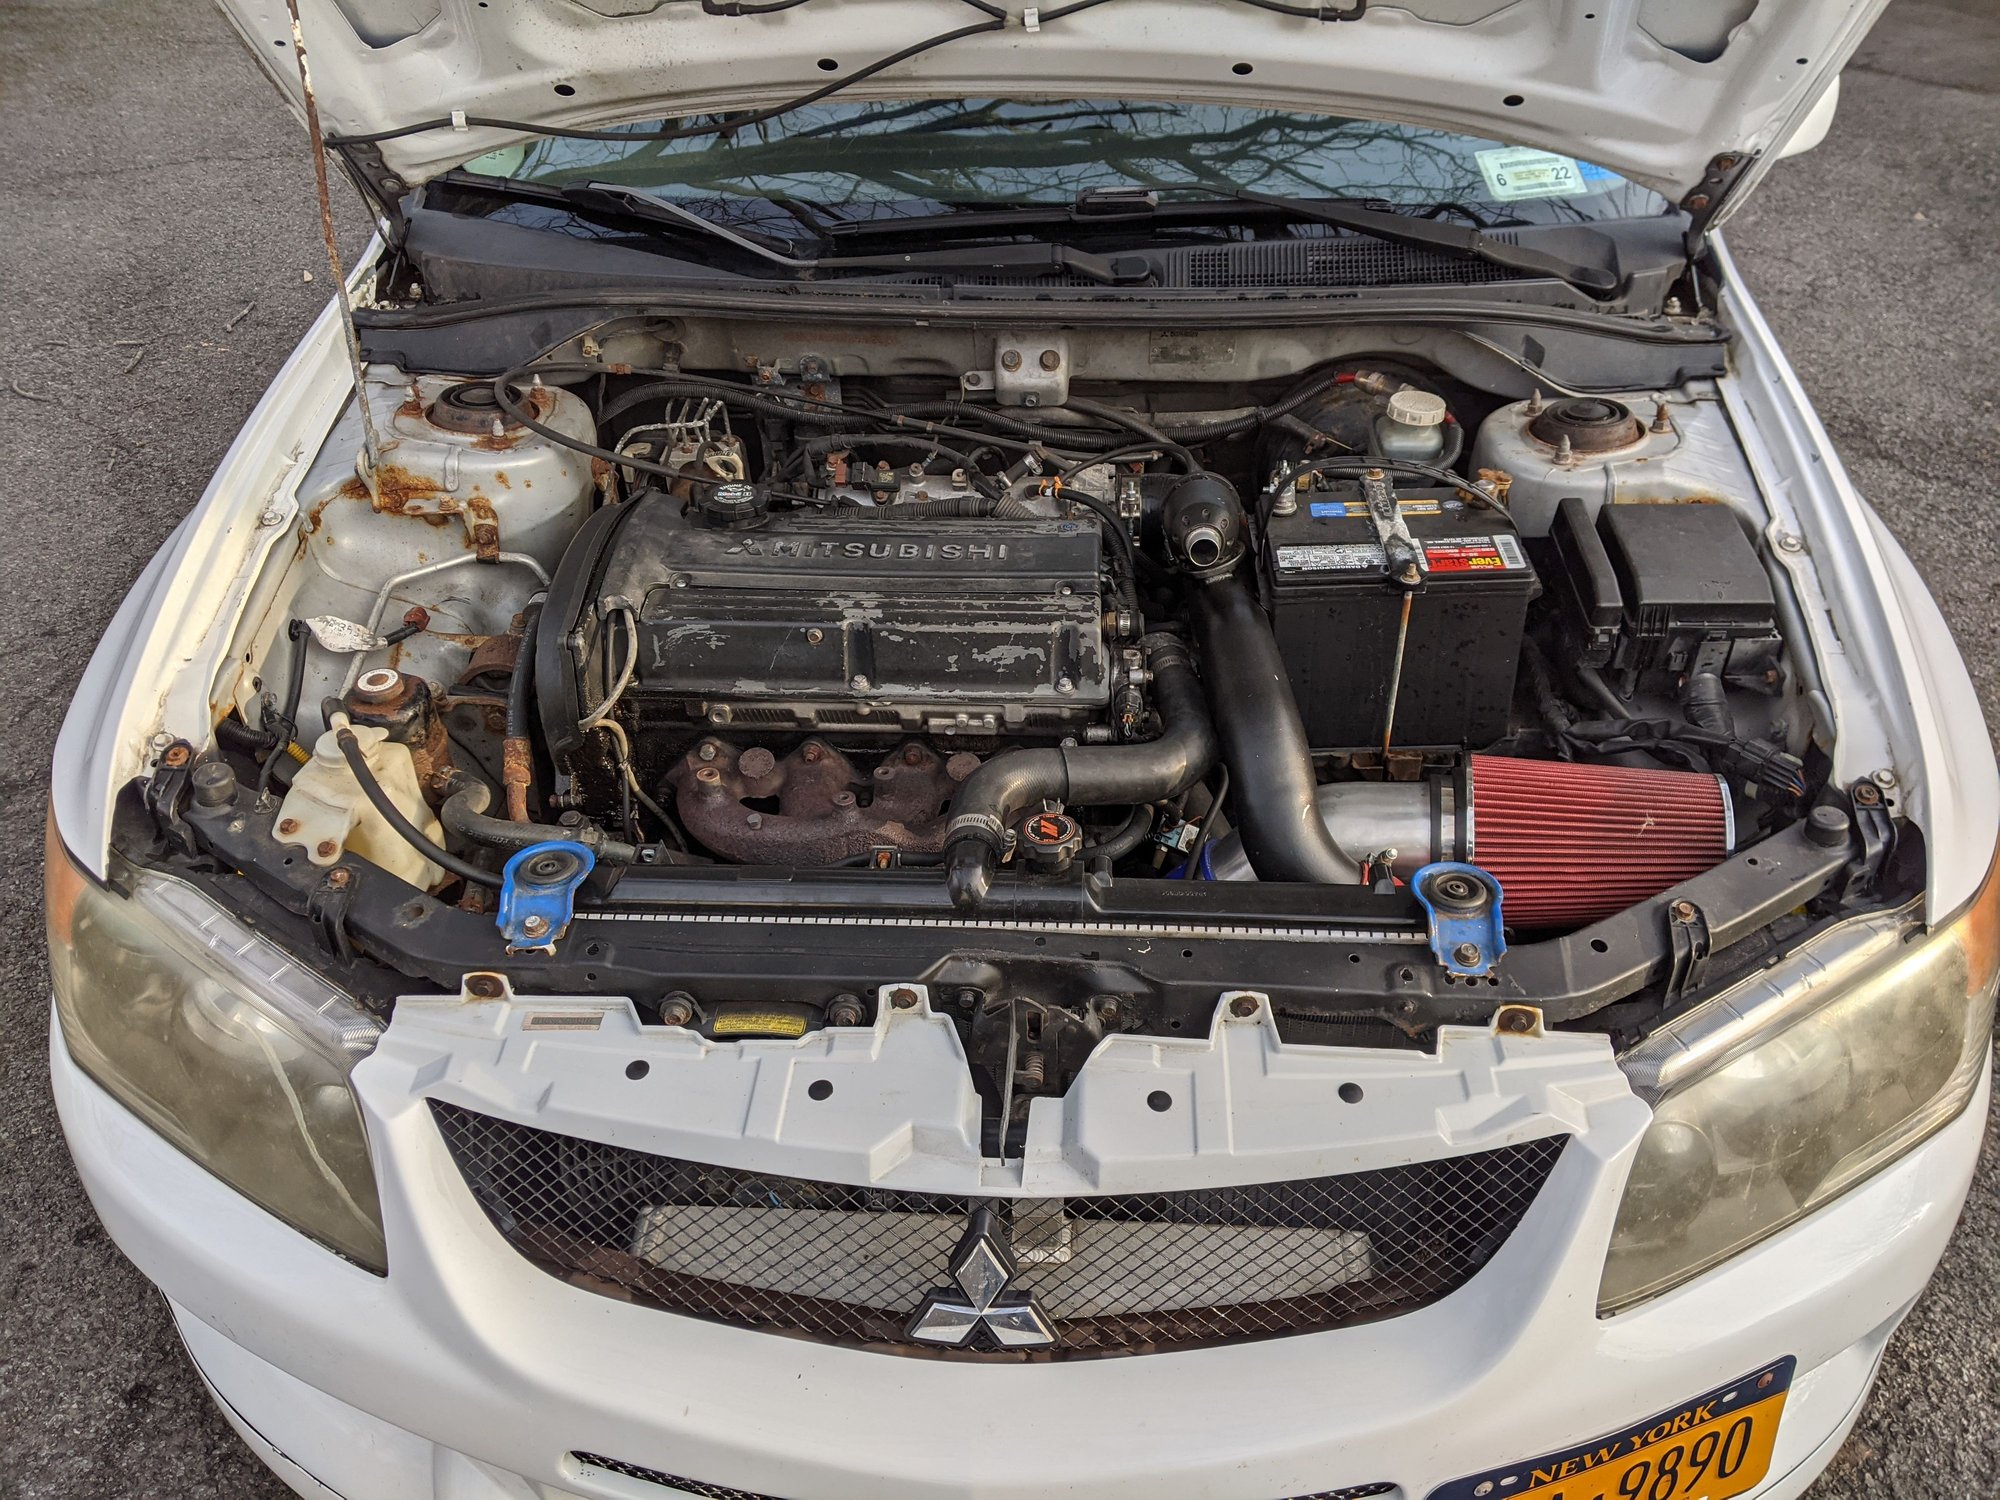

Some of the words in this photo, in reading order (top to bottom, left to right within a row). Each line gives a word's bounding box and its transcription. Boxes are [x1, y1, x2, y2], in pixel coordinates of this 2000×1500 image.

[1496, 173, 1507, 187] 6
[1551, 166, 1572, 181] 22
[771, 541, 1008, 561] MITSUBISHI
[1429, 556, 1502, 567] EverStart
[1528, 1442, 1620, 1488] NEW
[1630, 1400, 1718, 1450] YORK
[1618, 1416, 1753, 1500] 9890
